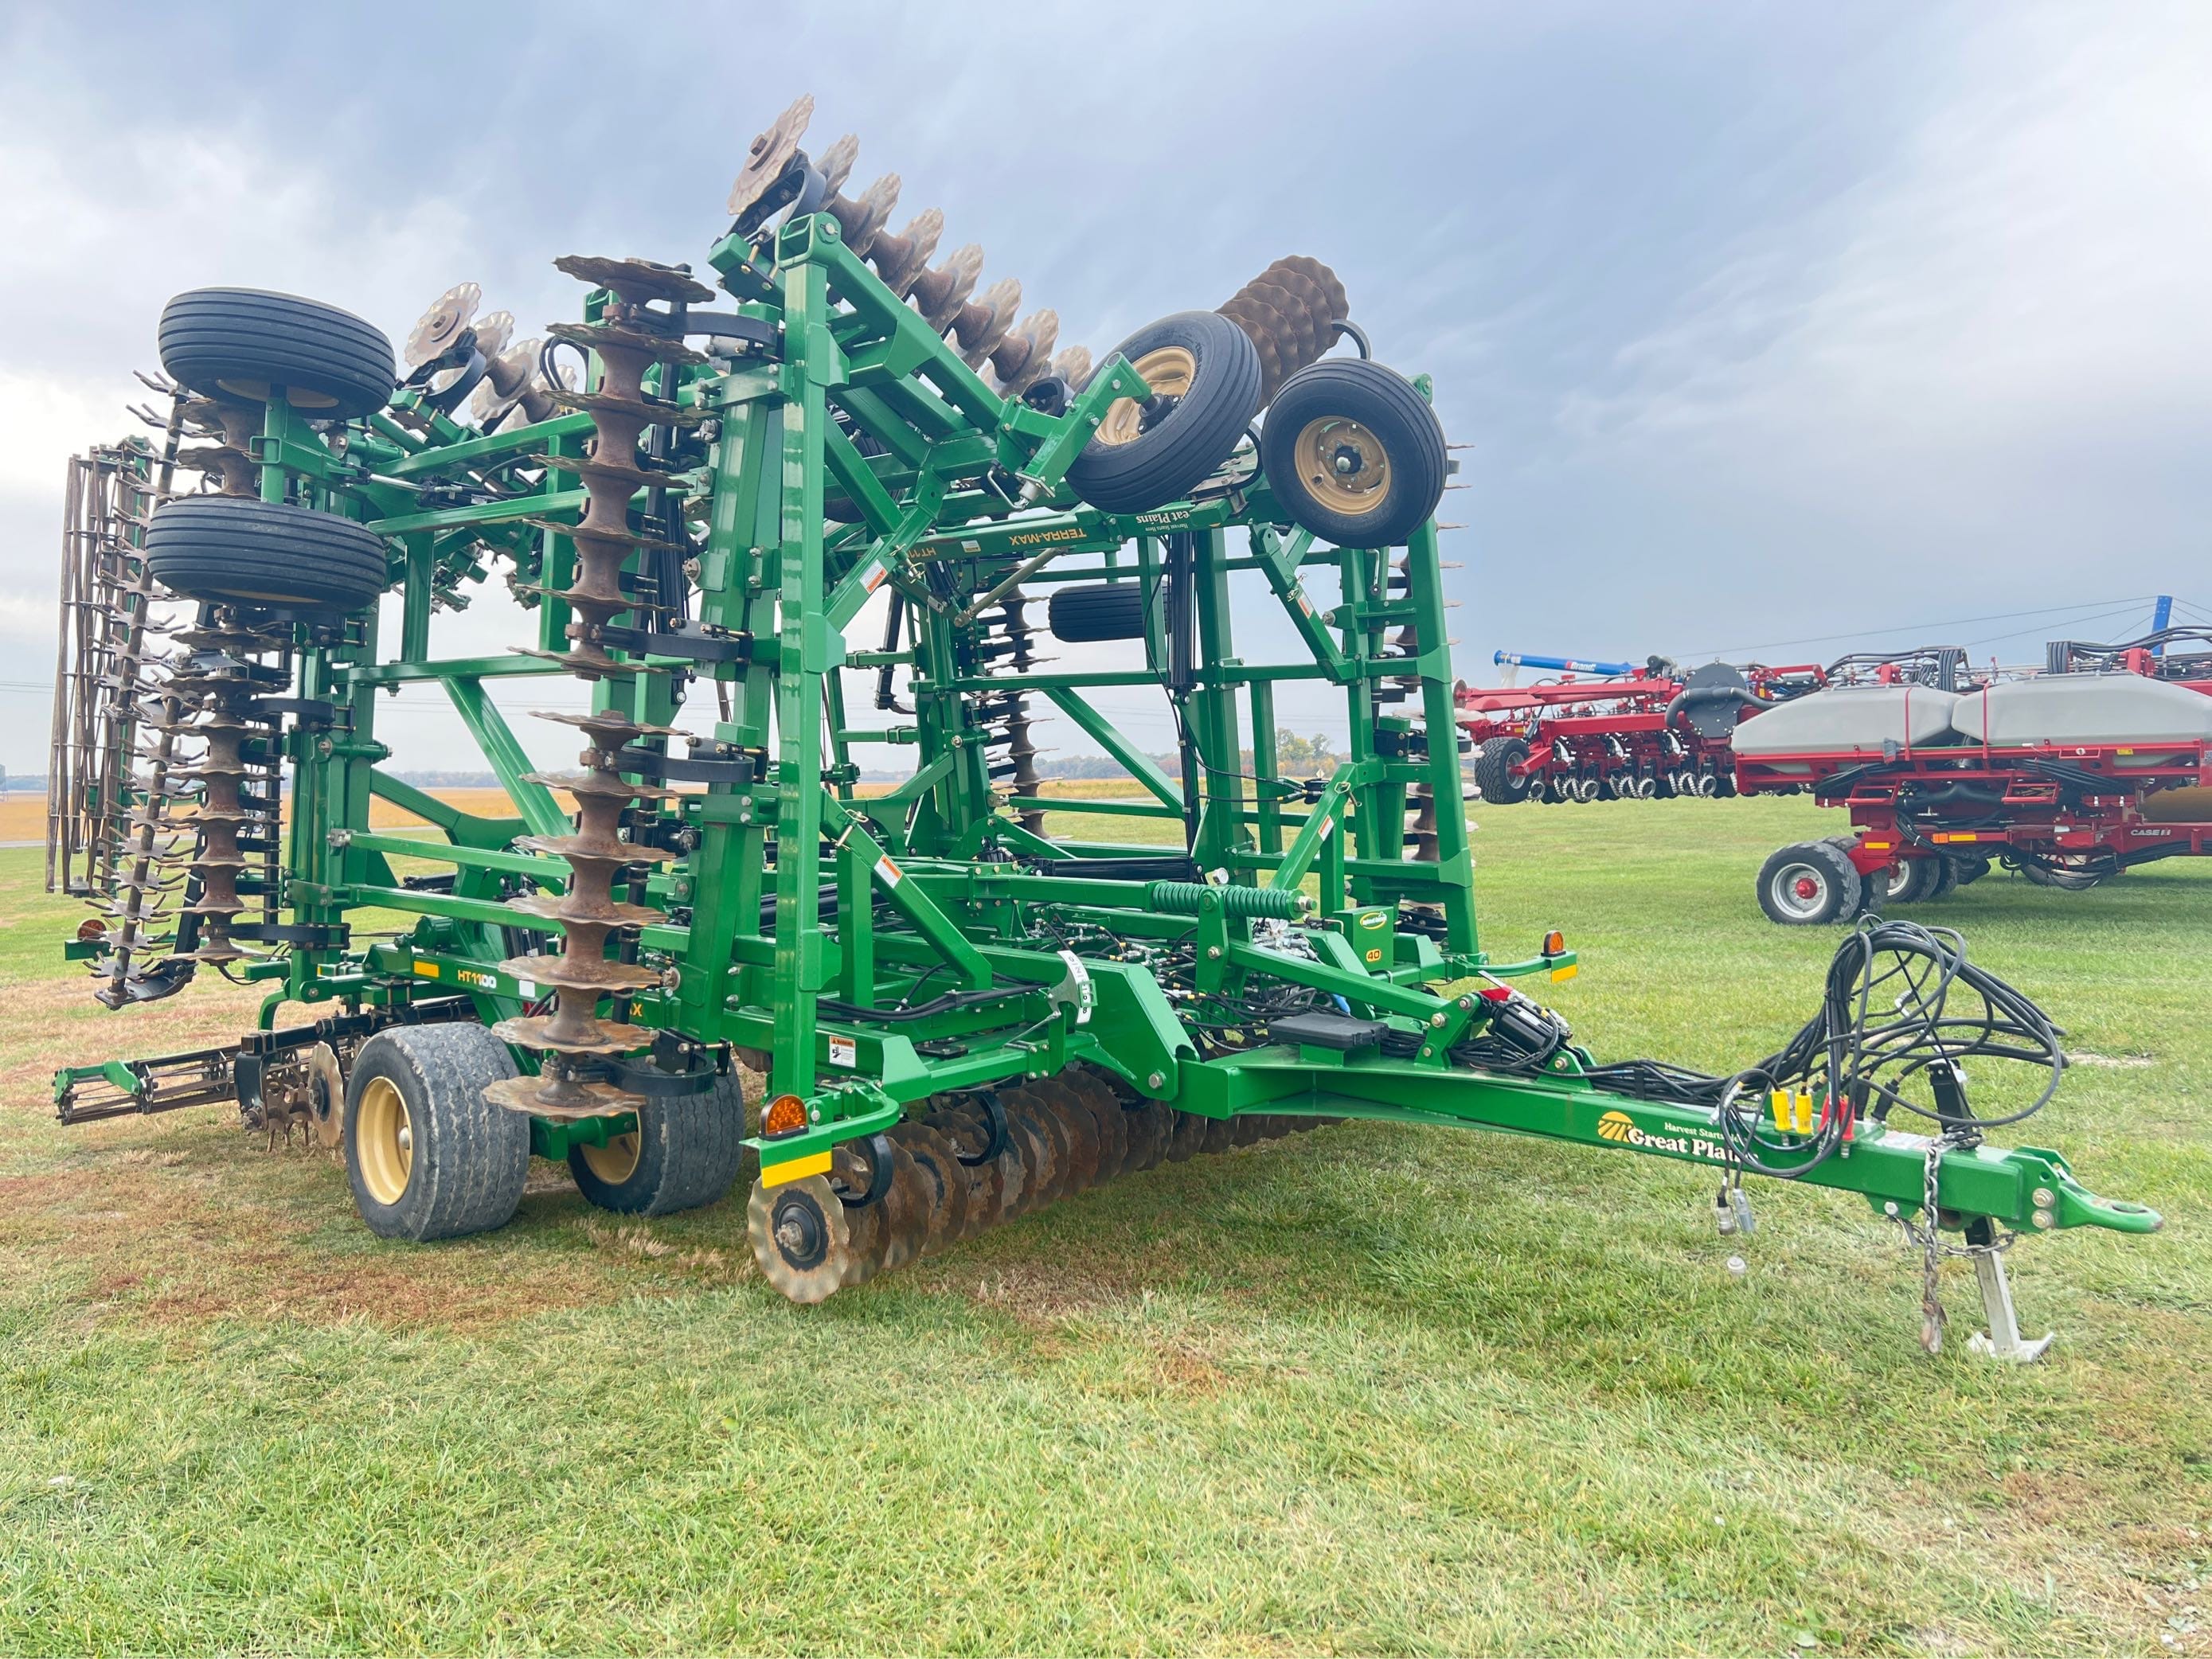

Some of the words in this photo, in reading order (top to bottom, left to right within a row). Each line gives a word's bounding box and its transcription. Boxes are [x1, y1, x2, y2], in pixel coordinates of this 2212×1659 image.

[1135, 512, 1171, 525] Plains
[1008, 528, 1087, 546] TERRA-MAX
[1570, 662, 1596, 672] Brandt
[1367, 950, 1380, 960] 40
[457, 969, 497, 989] HT1100
[1664, 1122, 1698, 1136] Harvest
[1628, 1128, 1688, 1153] Great
